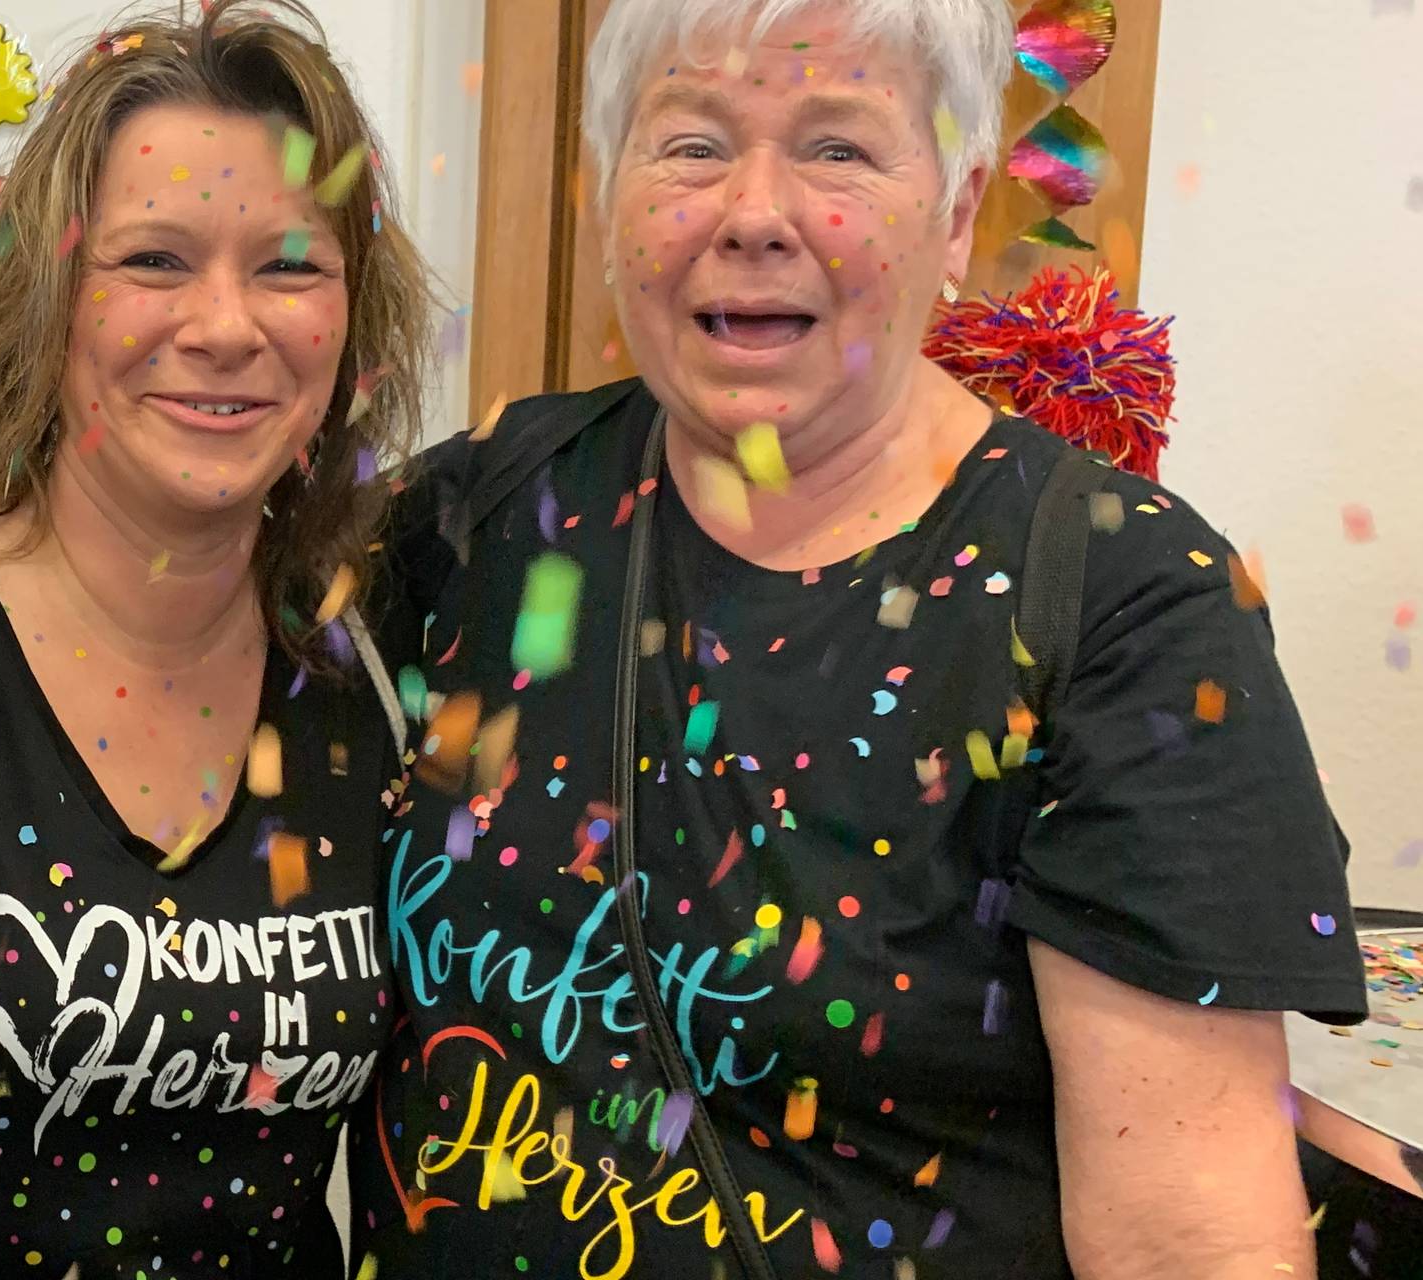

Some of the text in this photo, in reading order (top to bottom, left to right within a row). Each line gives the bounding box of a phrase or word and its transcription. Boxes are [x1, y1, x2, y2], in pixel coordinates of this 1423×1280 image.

[145, 905, 381, 984] KONFETTI
[388, 829, 779, 1096] Konfetti
[33, 997, 378, 1158] Herzen
[264, 990, 308, 1046] IM
[418, 1061, 805, 1280] Herzen
[589, 1087, 671, 1152] im
